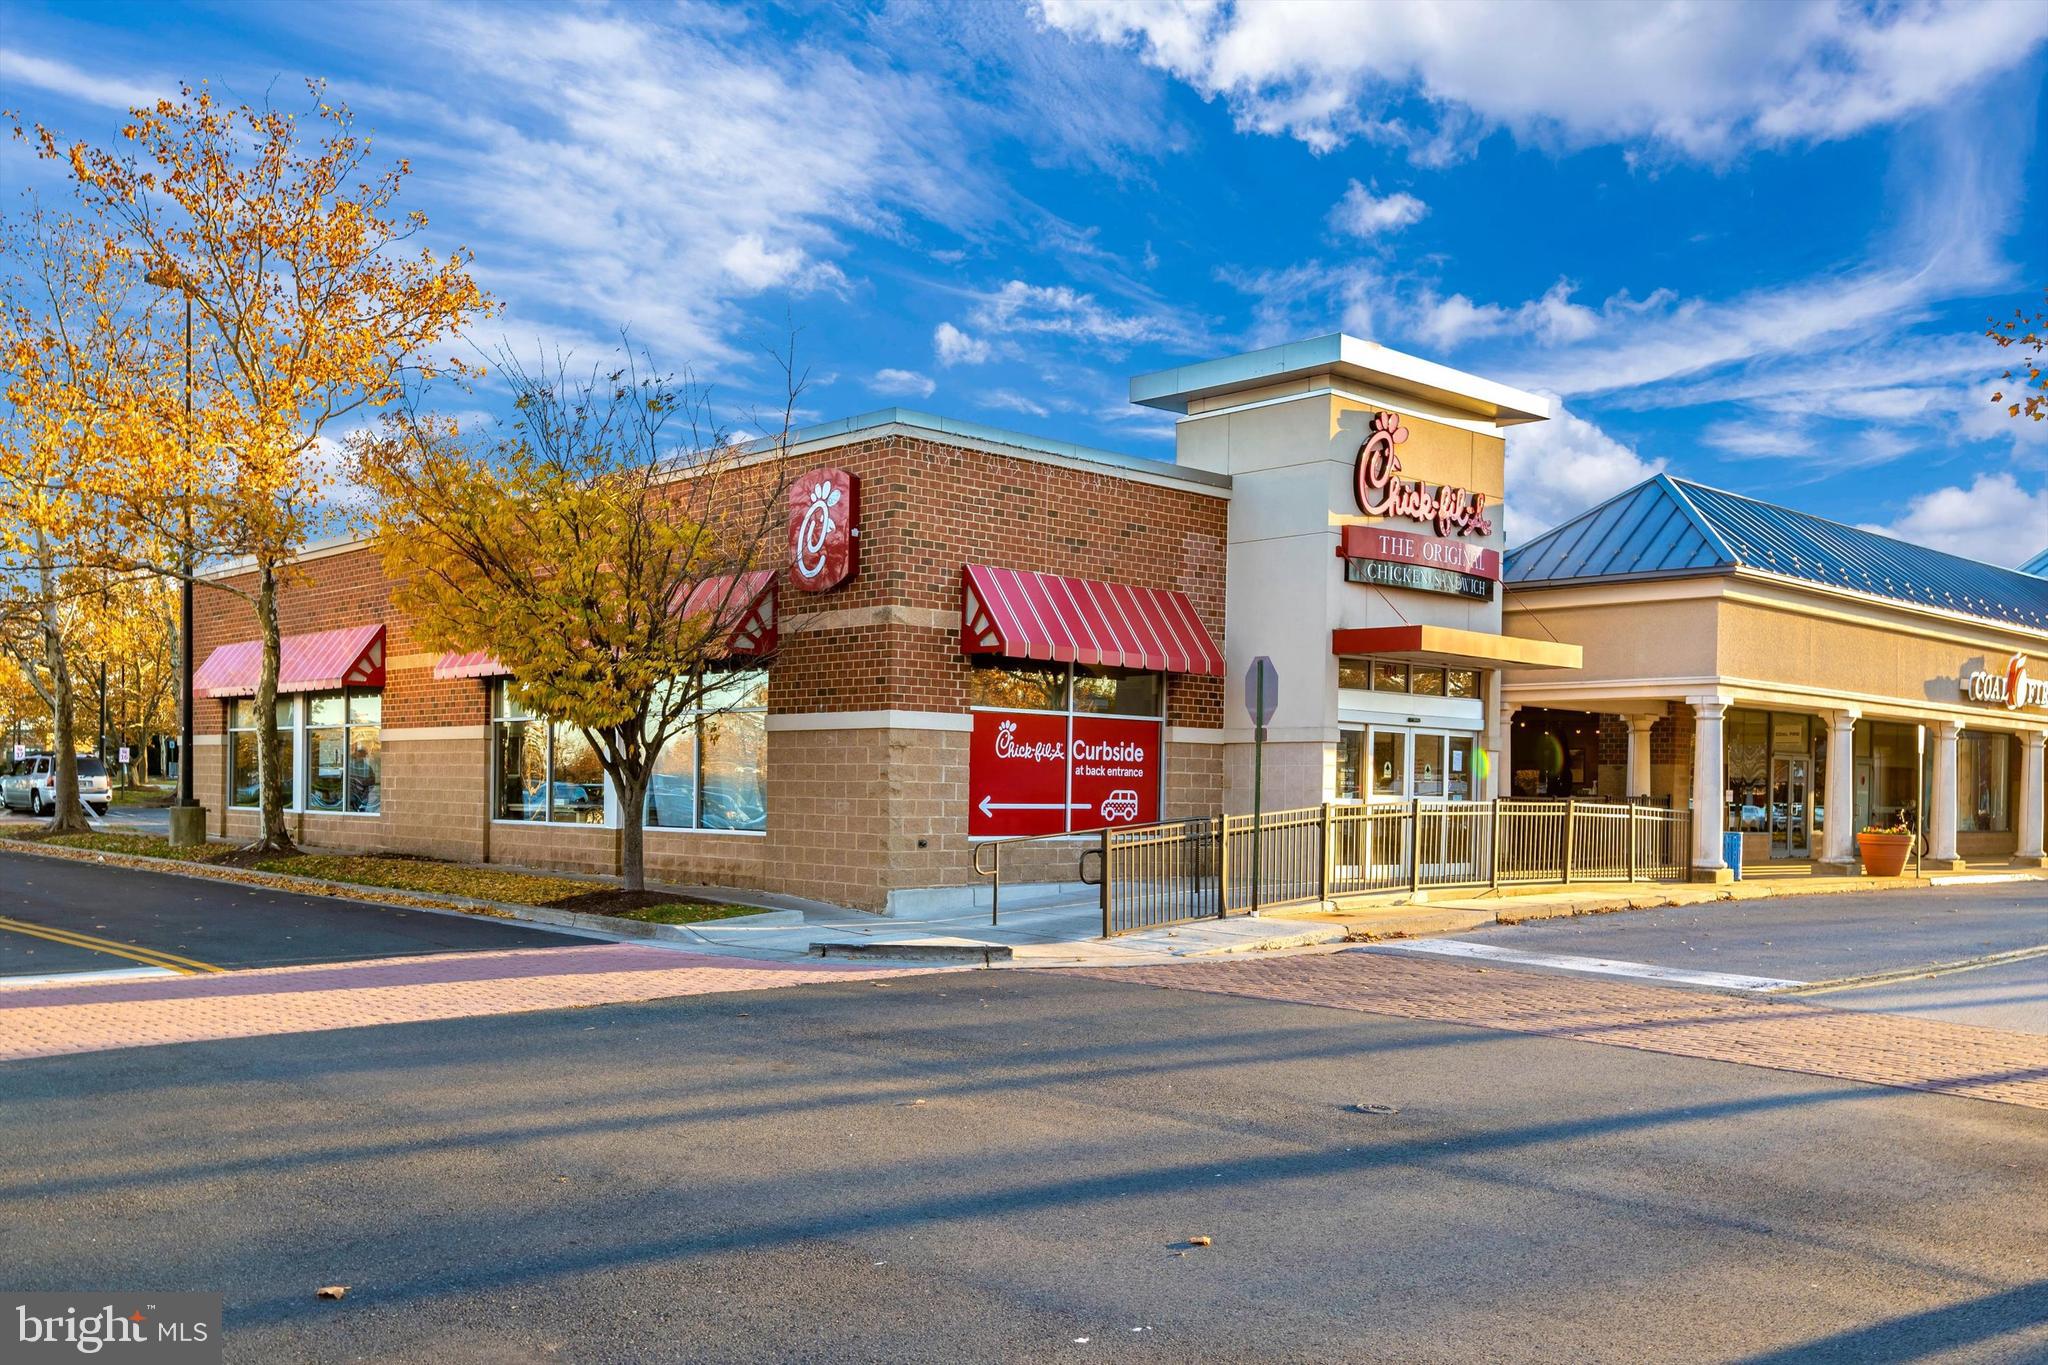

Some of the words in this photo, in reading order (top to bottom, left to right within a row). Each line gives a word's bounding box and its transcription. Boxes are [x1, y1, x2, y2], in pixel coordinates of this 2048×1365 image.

[1354, 430, 1492, 537] Chick-fil-A
[1379, 535, 1414, 558] THE
[1423, 542, 1485, 571] ORIGINAL
[1367, 563, 1428, 585] CHICKEN
[1434, 572, 1486, 596] SANDWICH
[1968, 671, 2009, 702] COAL
[995, 729, 1065, 763] Chick-fil-A
[1072, 739, 1145, 763] Curbside
[1075, 766, 1084, 776] at
[1085, 765, 1106, 776] back
[1107, 767, 1144, 778] entrance
